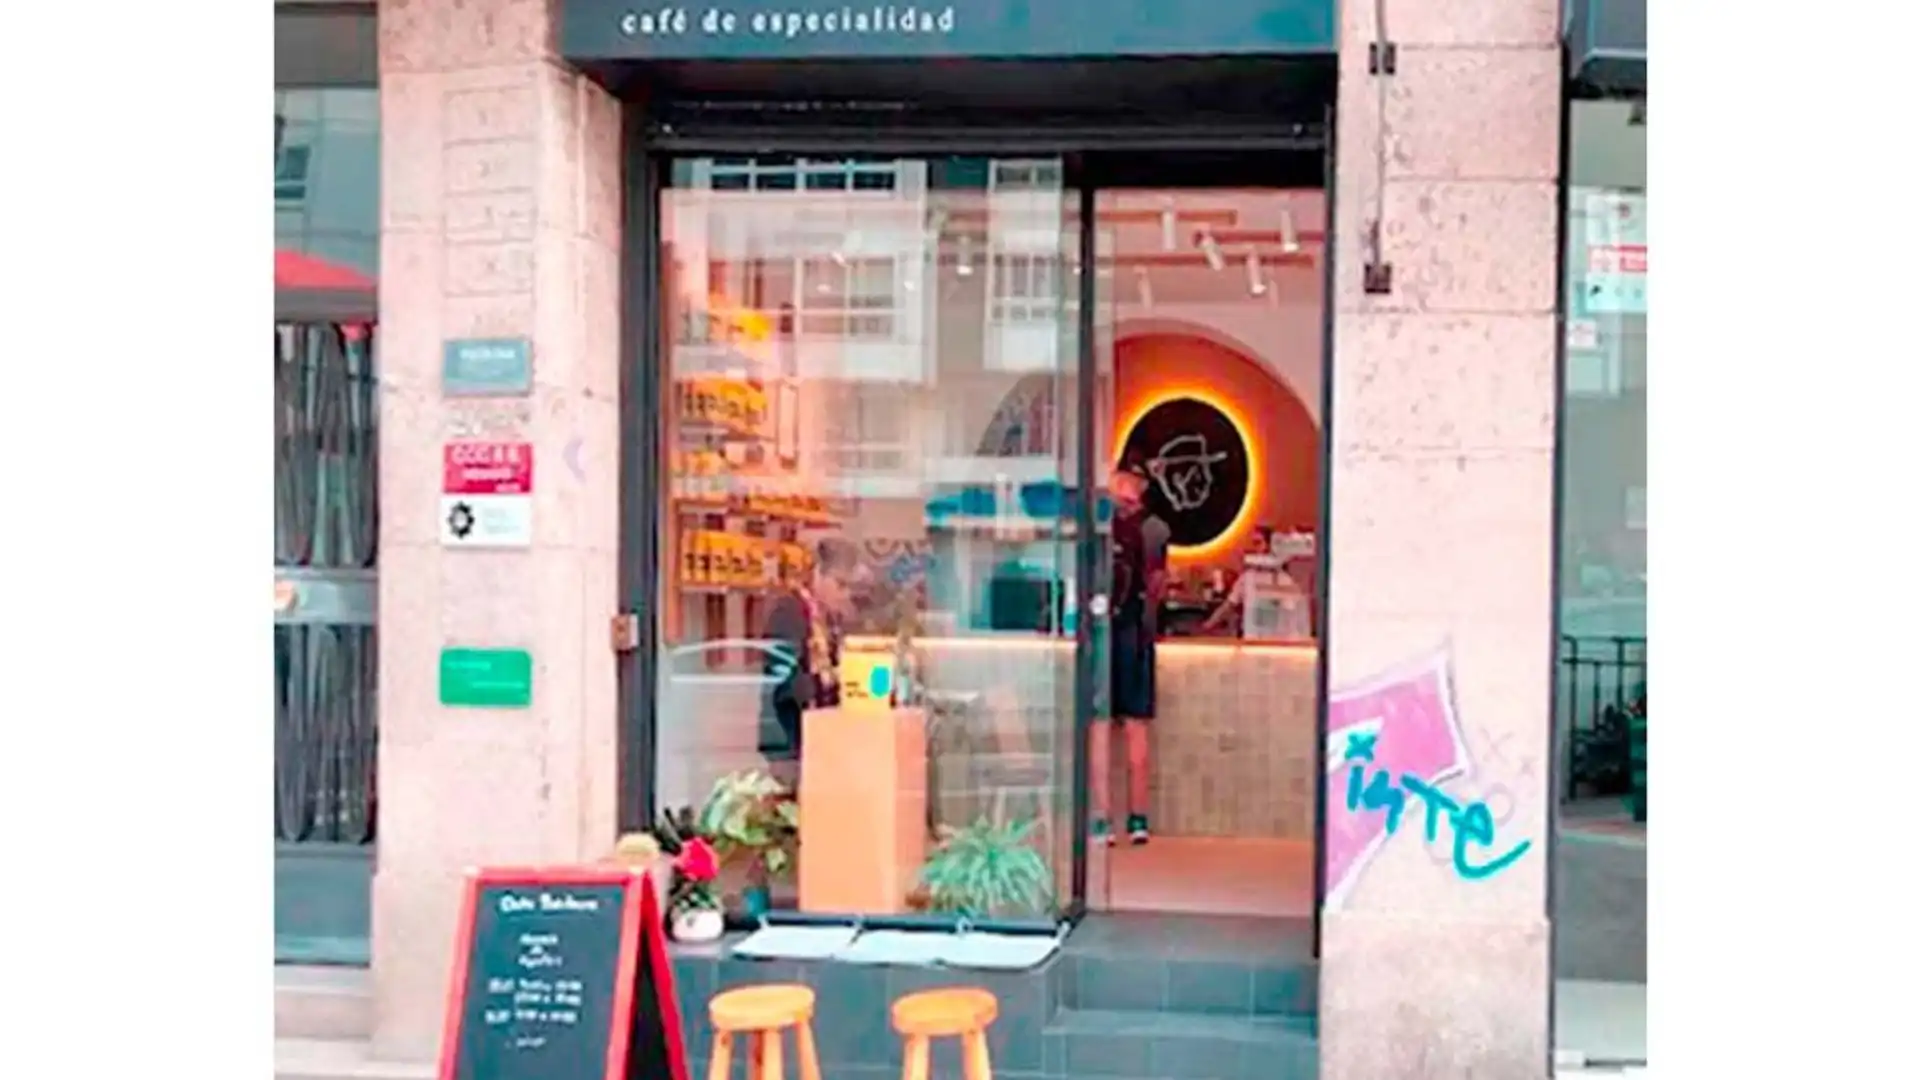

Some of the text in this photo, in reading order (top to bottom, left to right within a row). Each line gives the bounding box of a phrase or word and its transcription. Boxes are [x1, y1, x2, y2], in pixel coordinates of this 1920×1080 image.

[621, 8, 954, 37] café de especialidad
